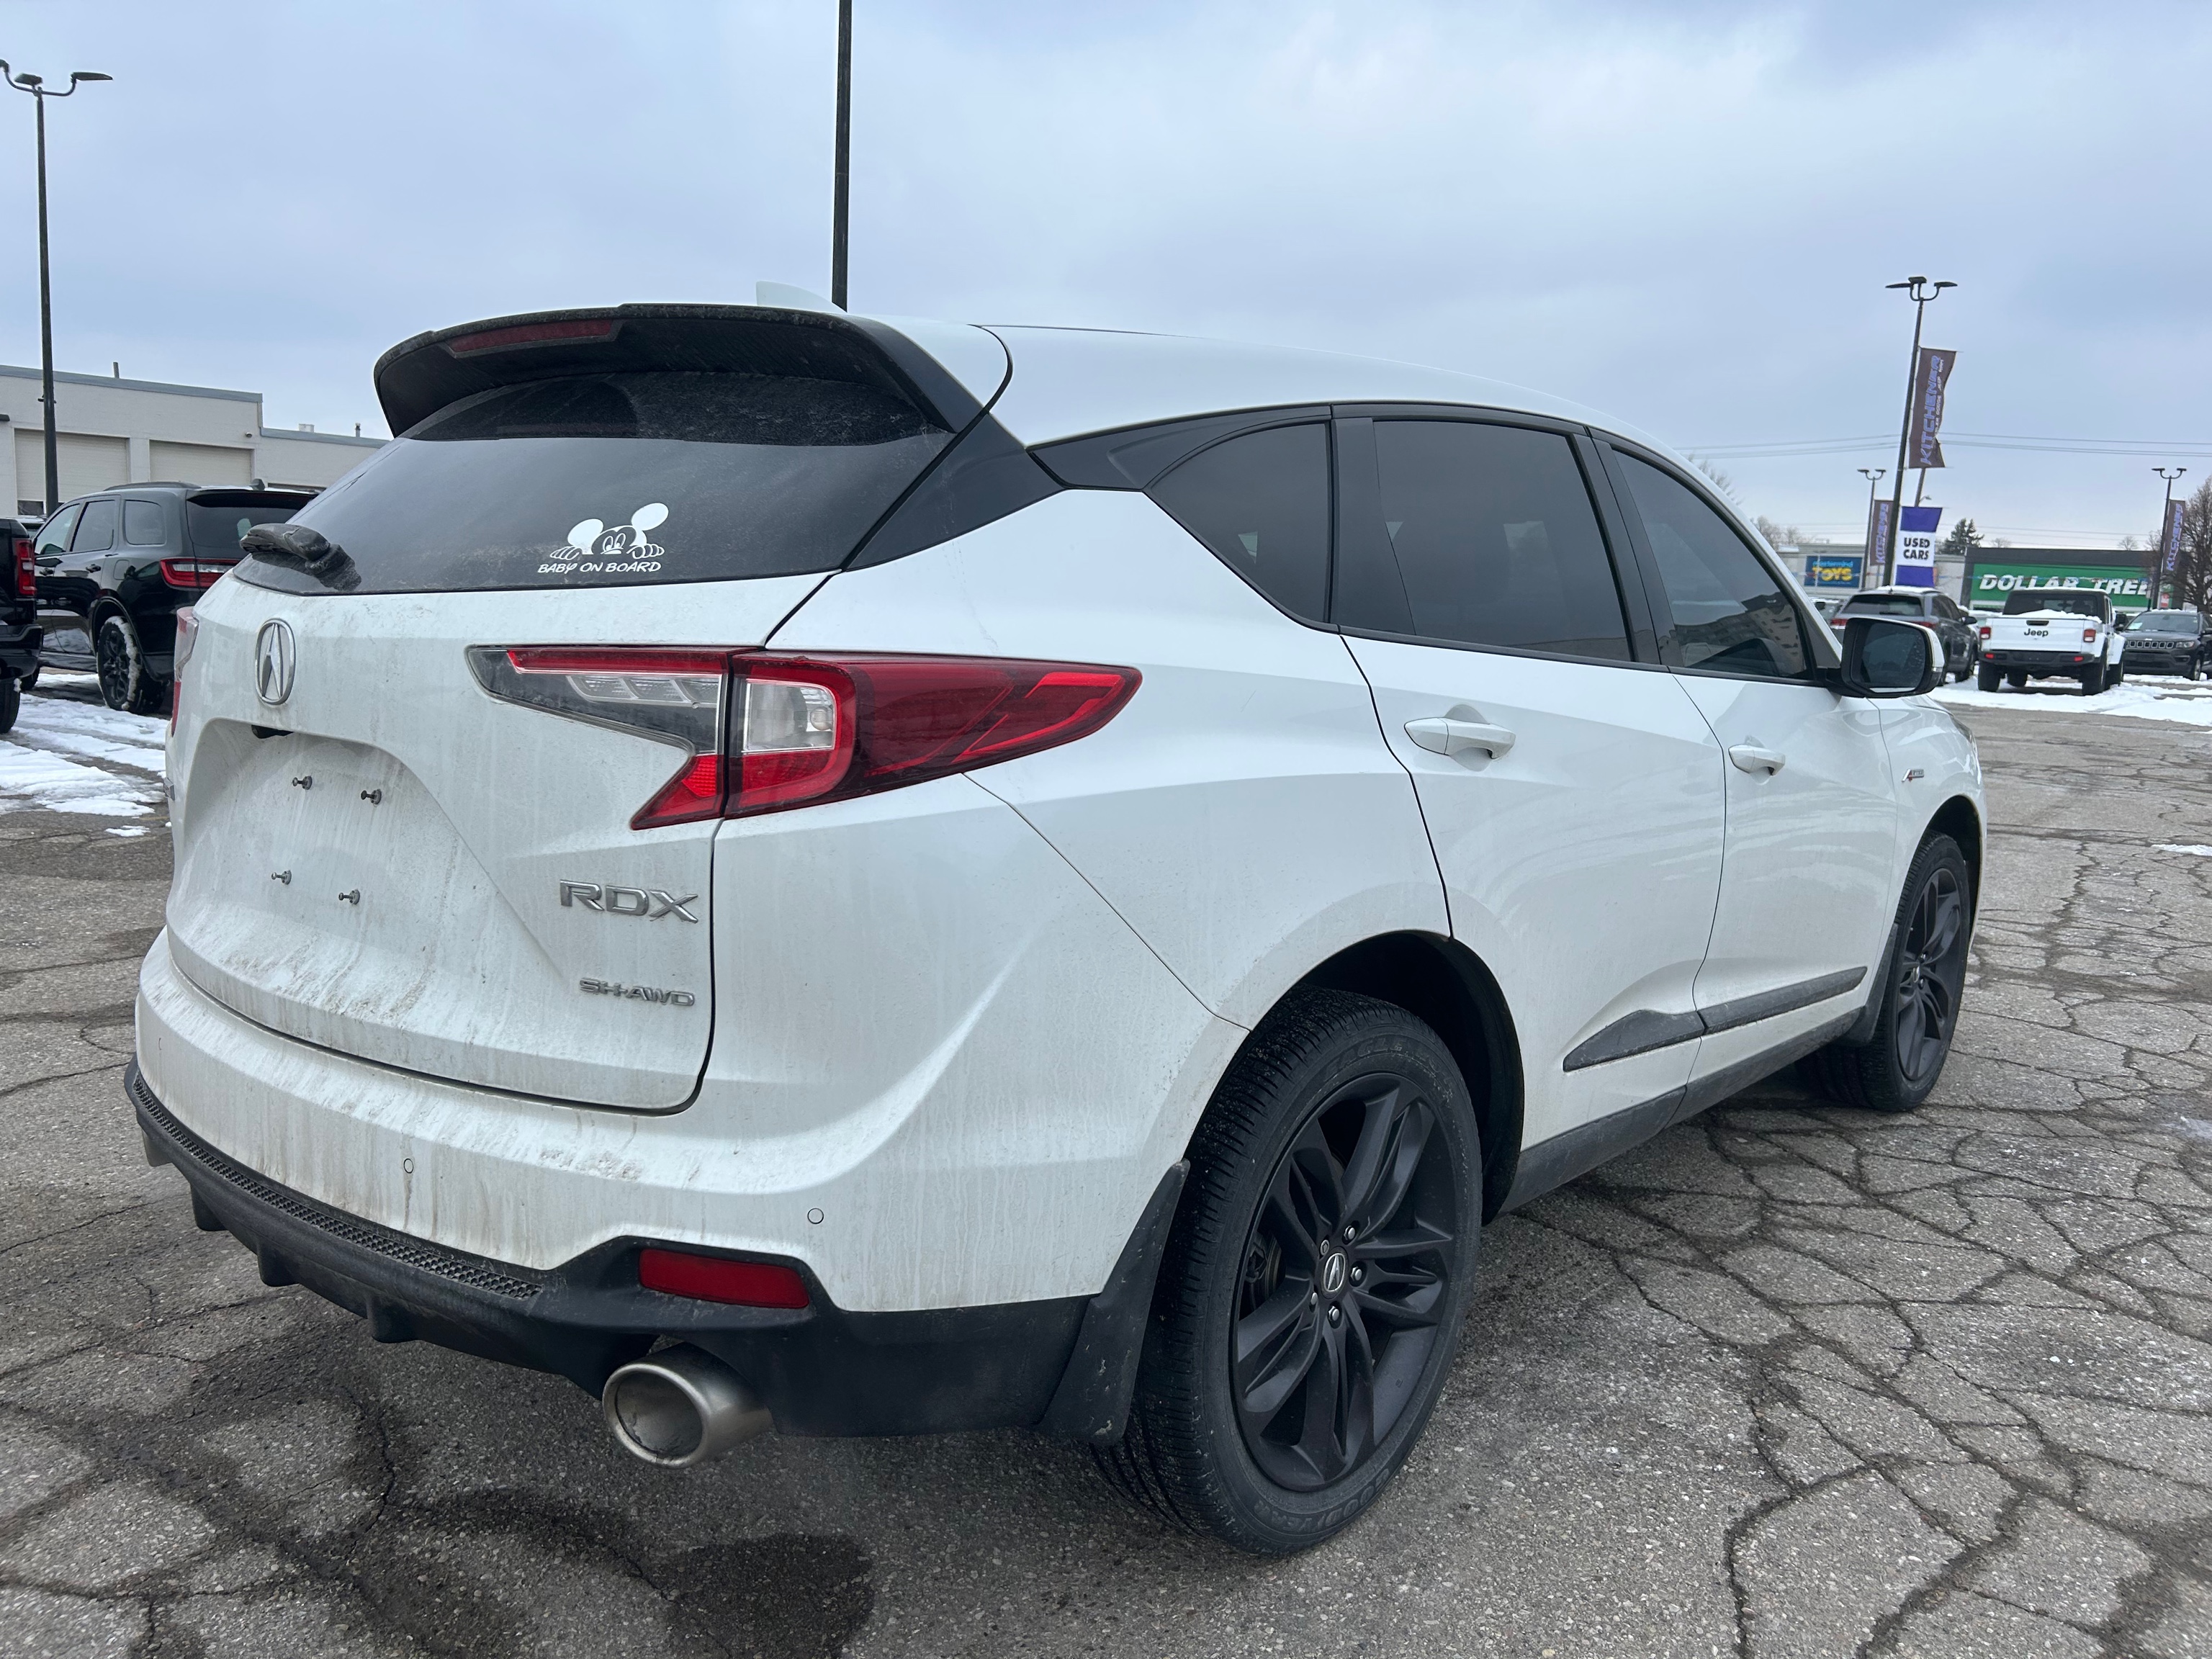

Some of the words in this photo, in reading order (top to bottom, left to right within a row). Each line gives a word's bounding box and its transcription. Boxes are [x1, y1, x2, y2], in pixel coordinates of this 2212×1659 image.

[1920, 355, 1941, 465] KITCHENER
[1903, 536, 1930, 549] USED
[1902, 549, 1929, 560] CARS
[537, 562, 578, 575] BABY
[580, 562, 603, 572] ON
[605, 561, 662, 572] BOARD
[1812, 567, 1853, 581] TOYS
[1979, 574, 2080, 592] DOLLAR
[2023, 628, 2049, 638] Jeep
[559, 879, 698, 924] RDX
[579, 977, 695, 1007] SH-AWD
